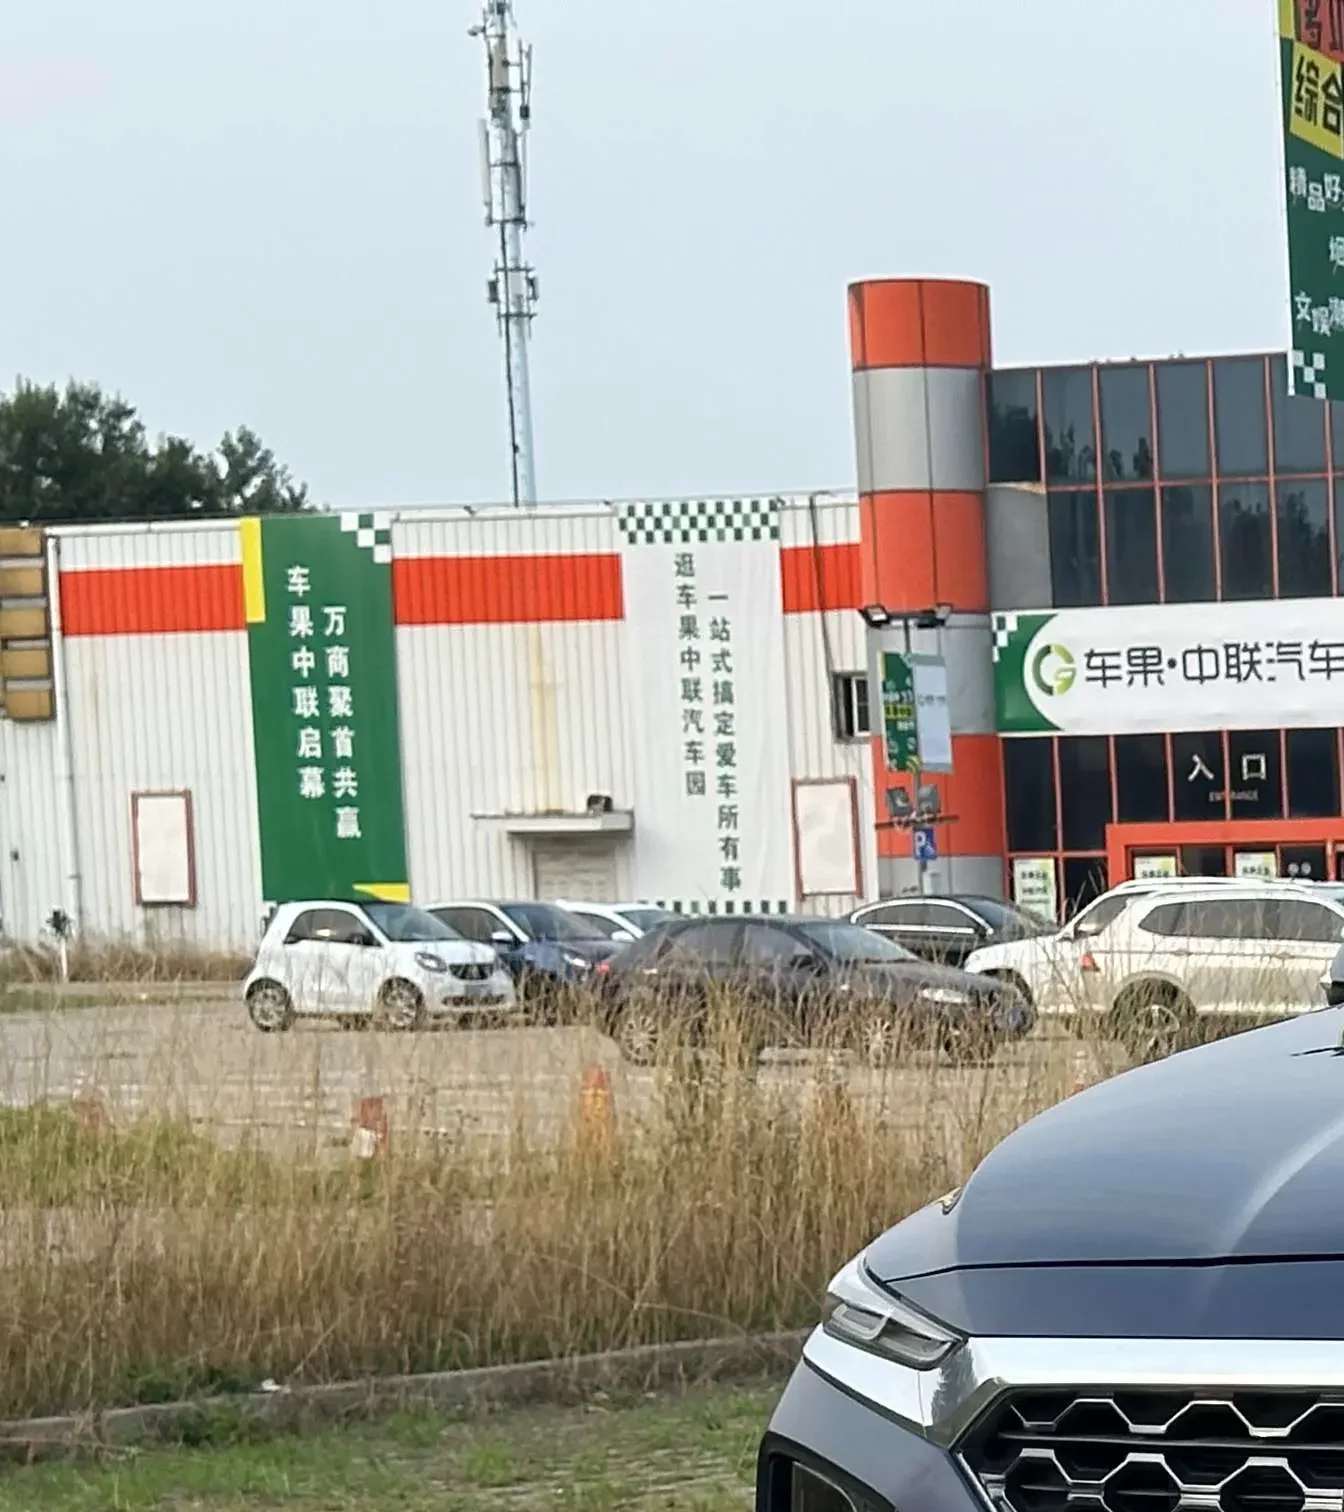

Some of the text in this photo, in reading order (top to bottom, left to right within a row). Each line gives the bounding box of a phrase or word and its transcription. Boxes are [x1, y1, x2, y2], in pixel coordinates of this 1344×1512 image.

[285, 565, 325, 799] 车果中联启幕
[321, 605, 361, 838] 万商聚首共赢
[674, 552, 706, 796] 逛车果中联汽车园
[707, 593, 742, 892] 一站式搞定爱车所有事
[1187, 753, 1267, 782] 入口
